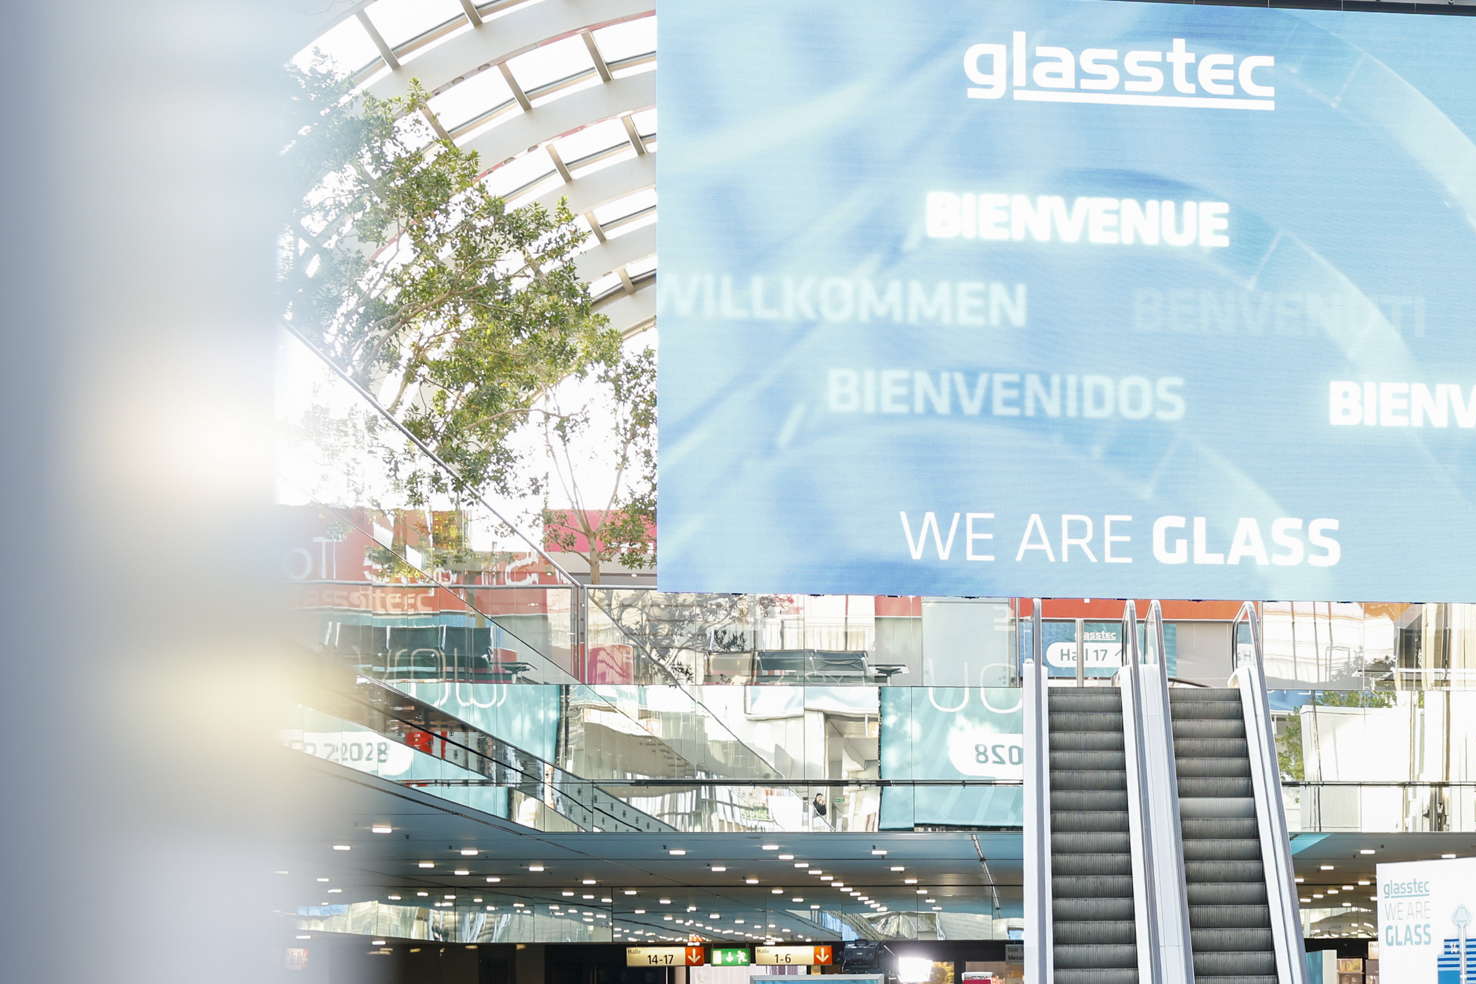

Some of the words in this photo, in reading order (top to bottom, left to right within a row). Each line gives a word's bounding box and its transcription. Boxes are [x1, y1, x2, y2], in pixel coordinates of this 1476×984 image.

[964, 31, 1275, 109] glasstec
[926, 191, 1229, 249] BIENVENUE
[657, 273, 1027, 328] WILLKOMMEN
[1133, 288, 1426, 338] BENVENUTI
[827, 368, 1185, 422] BIENVENIDOS
[900, 511, 995, 562] WE
[1015, 515, 1133, 564] ARE
[1152, 516, 1340, 568] GLASS
[1074, 632, 1117, 640] gasstec
[1060, 648, 1088, 662] Hal
[1093, 649, 1108, 662] 17
[1383, 878, 1430, 899] glasstec
[1384, 902, 1403, 921] WE
[1407, 901, 1431, 920] ARE
[1385, 924, 1431, 946] GLASS
[757, 947, 771, 955] Halle
[1449, 942, 1458, 954] 14
[647, 954, 674, 965] 14-17
[775, 953, 791, 964] 1-6
